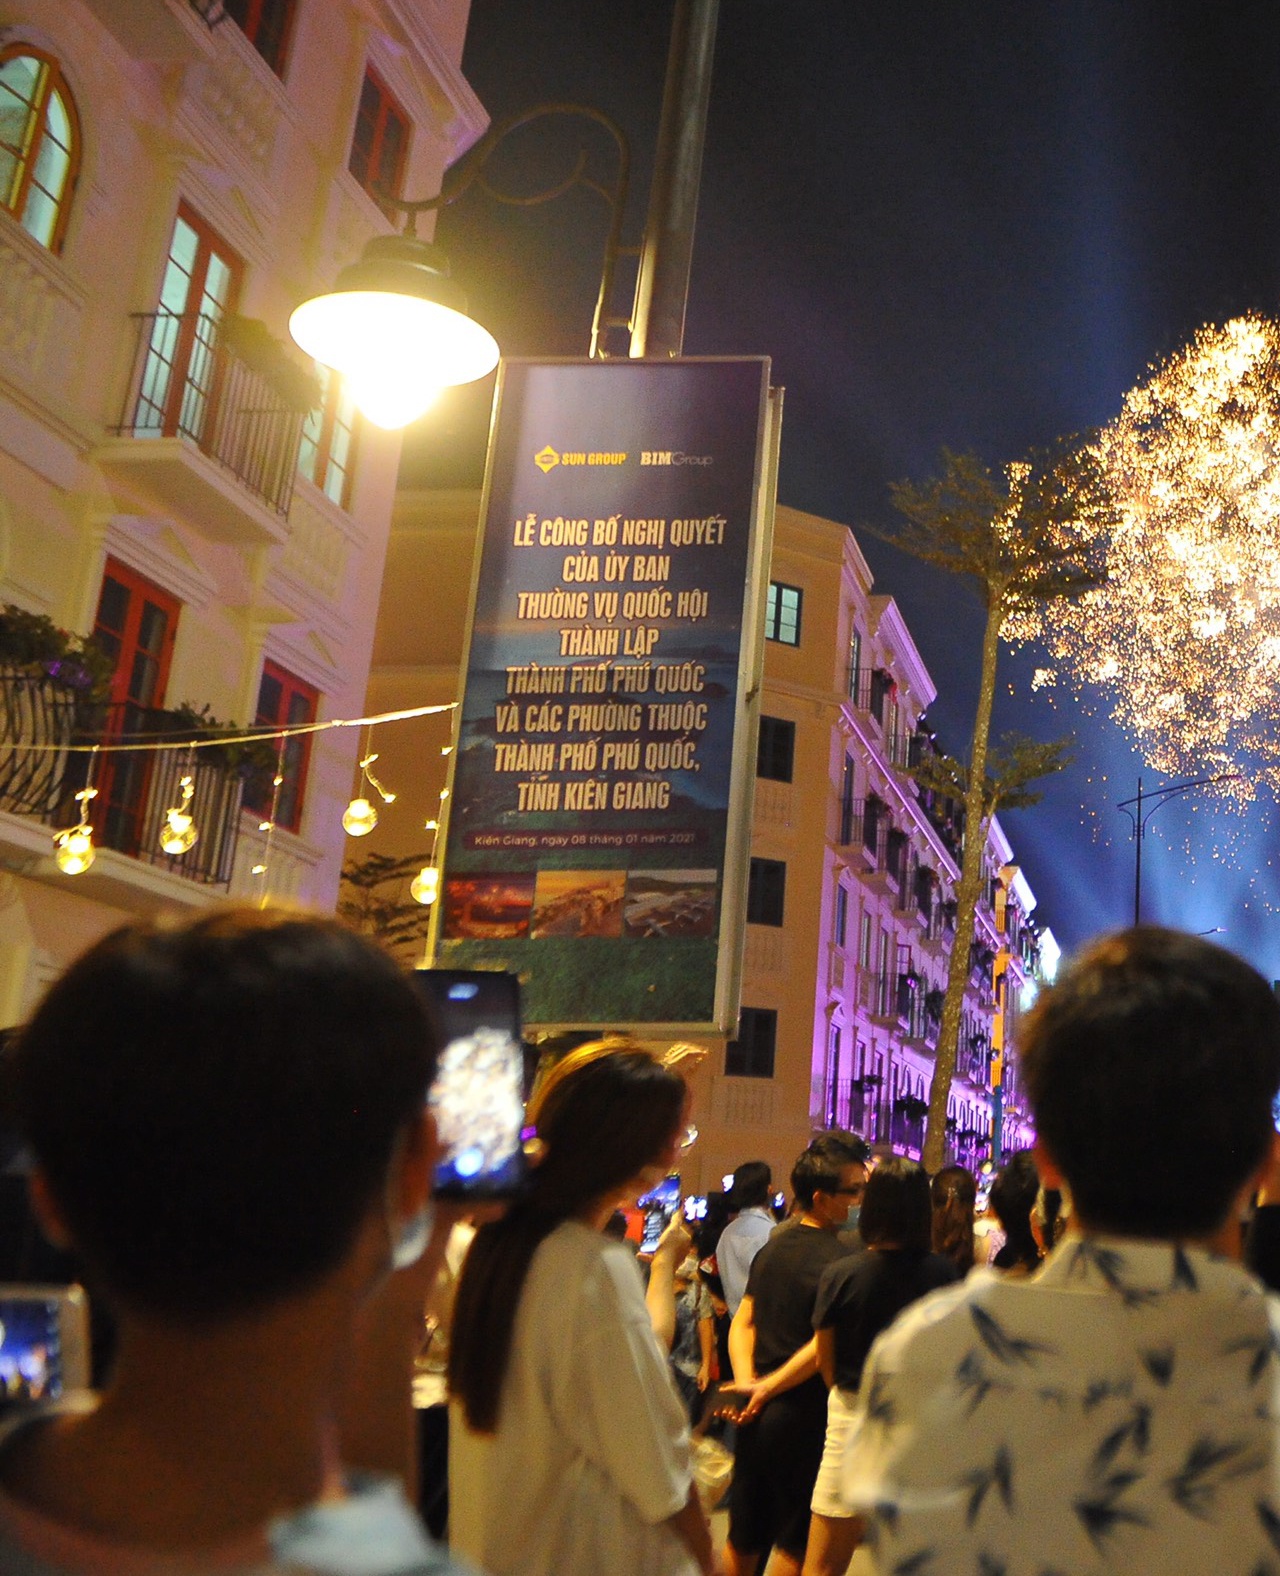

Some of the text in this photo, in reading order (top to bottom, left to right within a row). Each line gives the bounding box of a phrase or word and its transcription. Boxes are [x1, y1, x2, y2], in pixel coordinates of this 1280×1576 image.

[561, 452, 627, 466] SUN GROUP
[513, 513, 727, 550] LỄ CÔNG BỐ NGHỊ QUYẾT
[562, 550, 670, 583] CỦA ỦY BAN
[518, 586, 709, 623] THƯỜNG VỤ QUỐC HỘI
[559, 625, 660, 658] THÀNH LẬP
[505, 659, 706, 694] THÀNH PHỐ PHÚ QUỐC
[495, 699, 708, 735] VÀ CÁC PHƯỜNG THUỘC
[494, 739, 555, 772] THÀNH
[559, 737, 601, 771] PHỐ
[602, 739, 642, 771] PHÚ
[564, 778, 610, 811] KIÊN
[612, 781, 671, 810] GIANG
[571, 835, 587, 845] 08
[625, 834, 638, 844] 01
[669, 833, 696, 843] 2021
